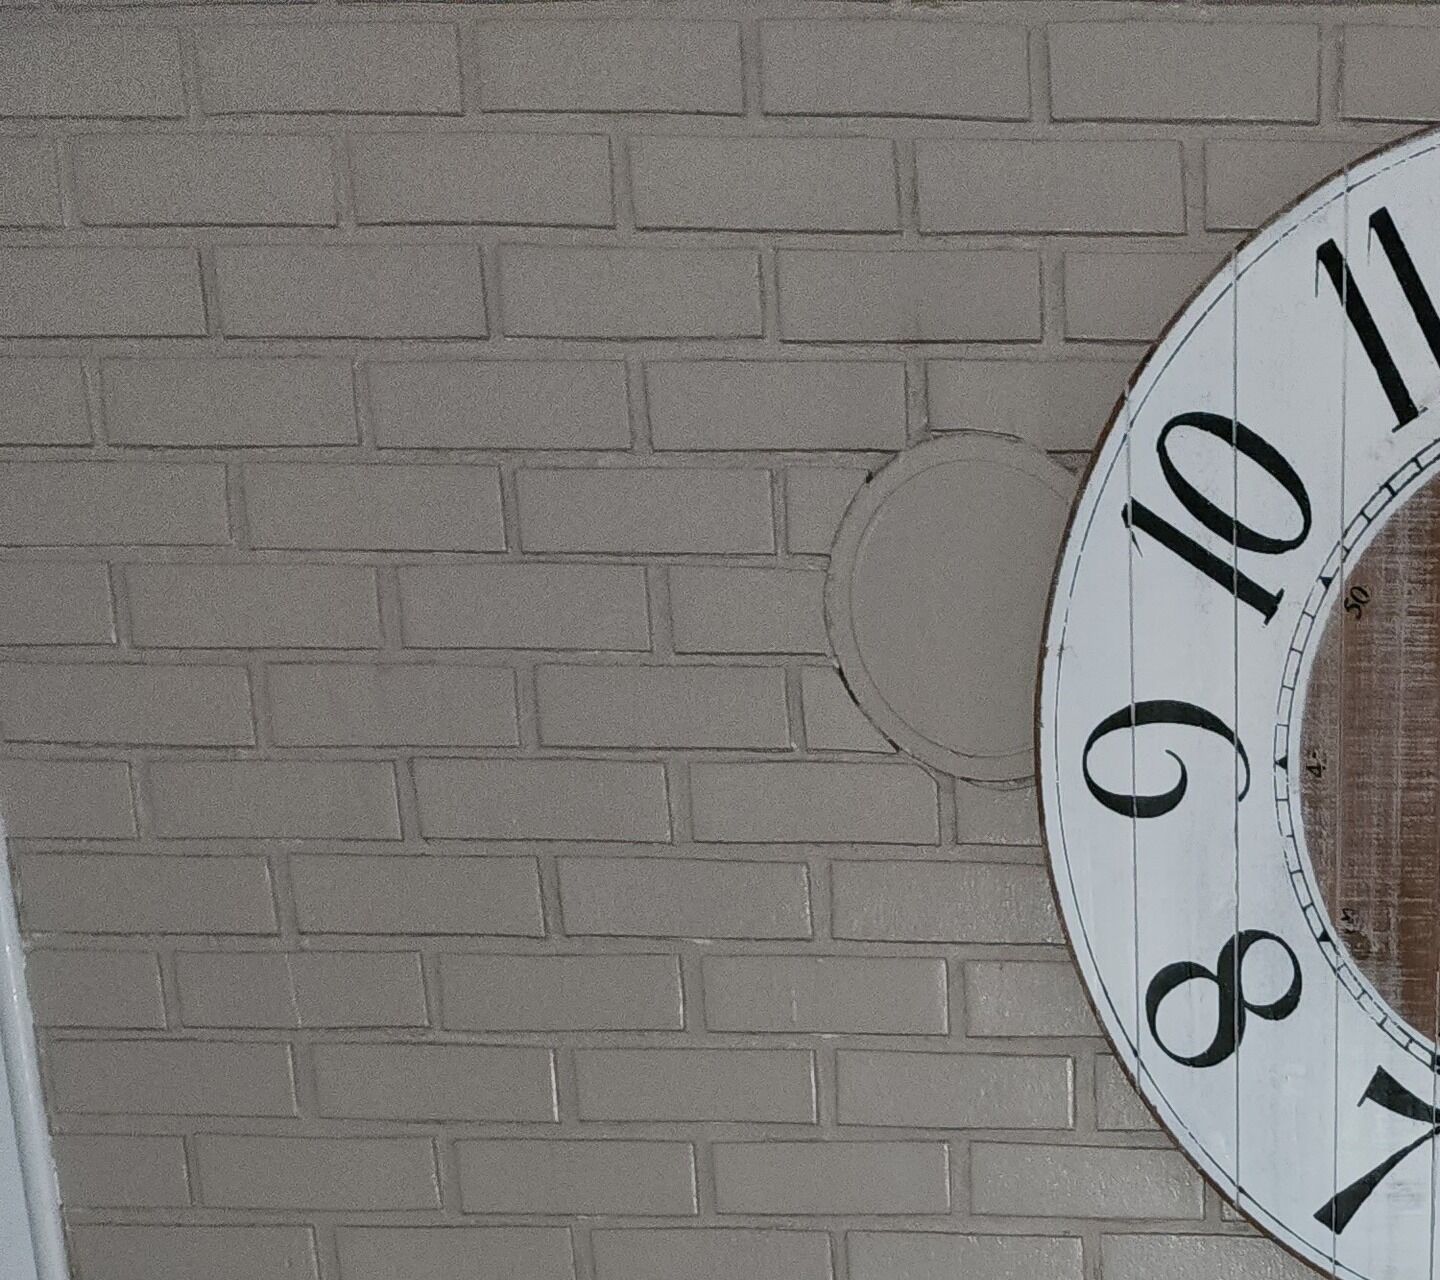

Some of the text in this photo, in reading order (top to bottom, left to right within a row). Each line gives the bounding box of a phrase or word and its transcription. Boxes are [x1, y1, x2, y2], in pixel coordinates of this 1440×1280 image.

[1122, 412, 1312, 624] 10
[1083, 699, 1251, 819] 9
[1145, 929, 1302, 1068] 8
